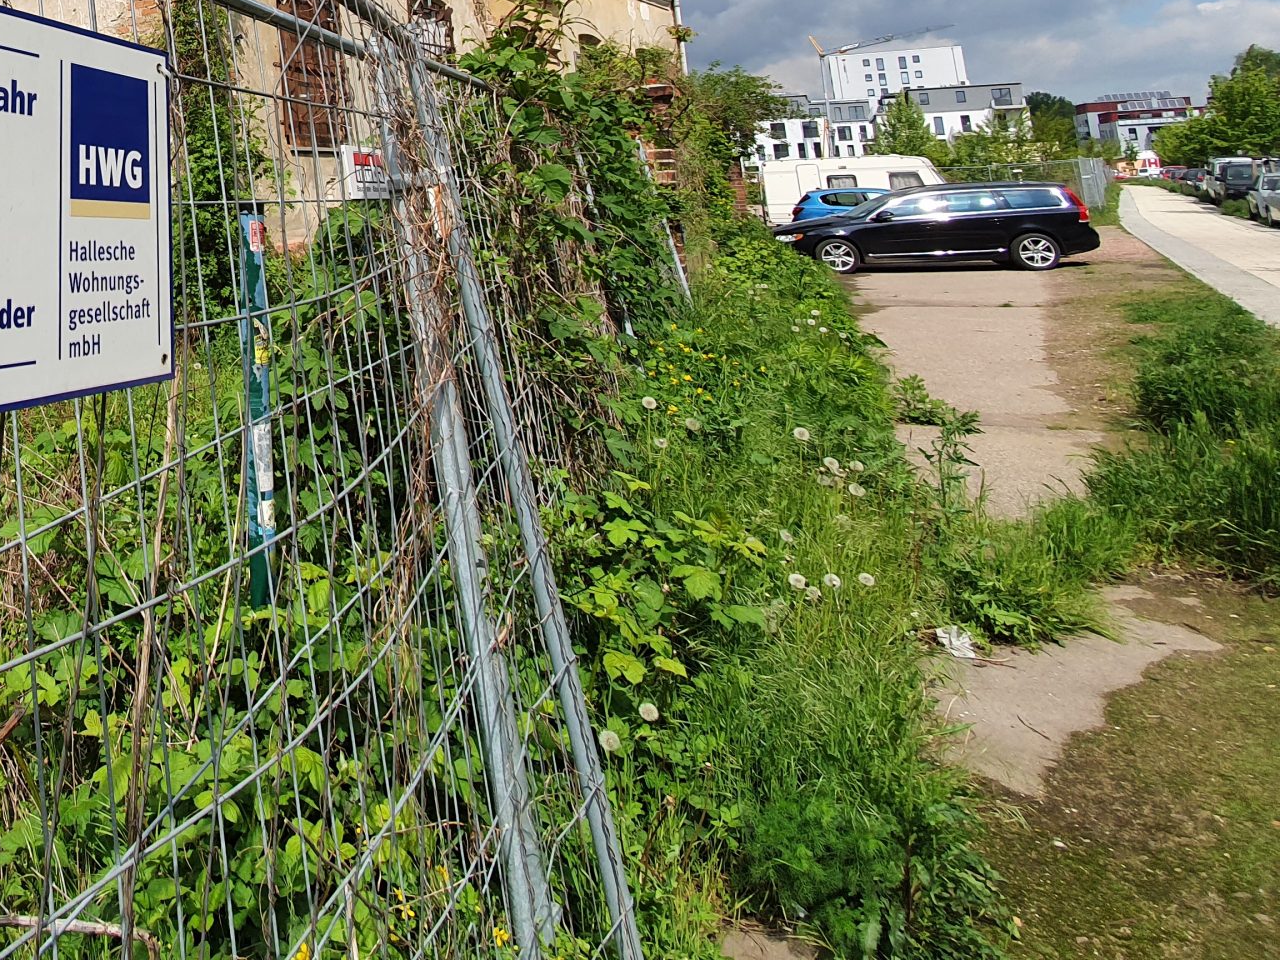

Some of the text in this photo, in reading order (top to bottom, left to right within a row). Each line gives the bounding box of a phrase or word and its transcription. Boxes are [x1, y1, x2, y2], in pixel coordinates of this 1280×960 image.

[79, 144, 143, 190] HWG
[69, 240, 136, 262] Hallesche
[69, 271, 145, 295] Wohnungs-
[69, 297, 151, 331] gesellschaft
[69, 334, 102, 359] mbH
